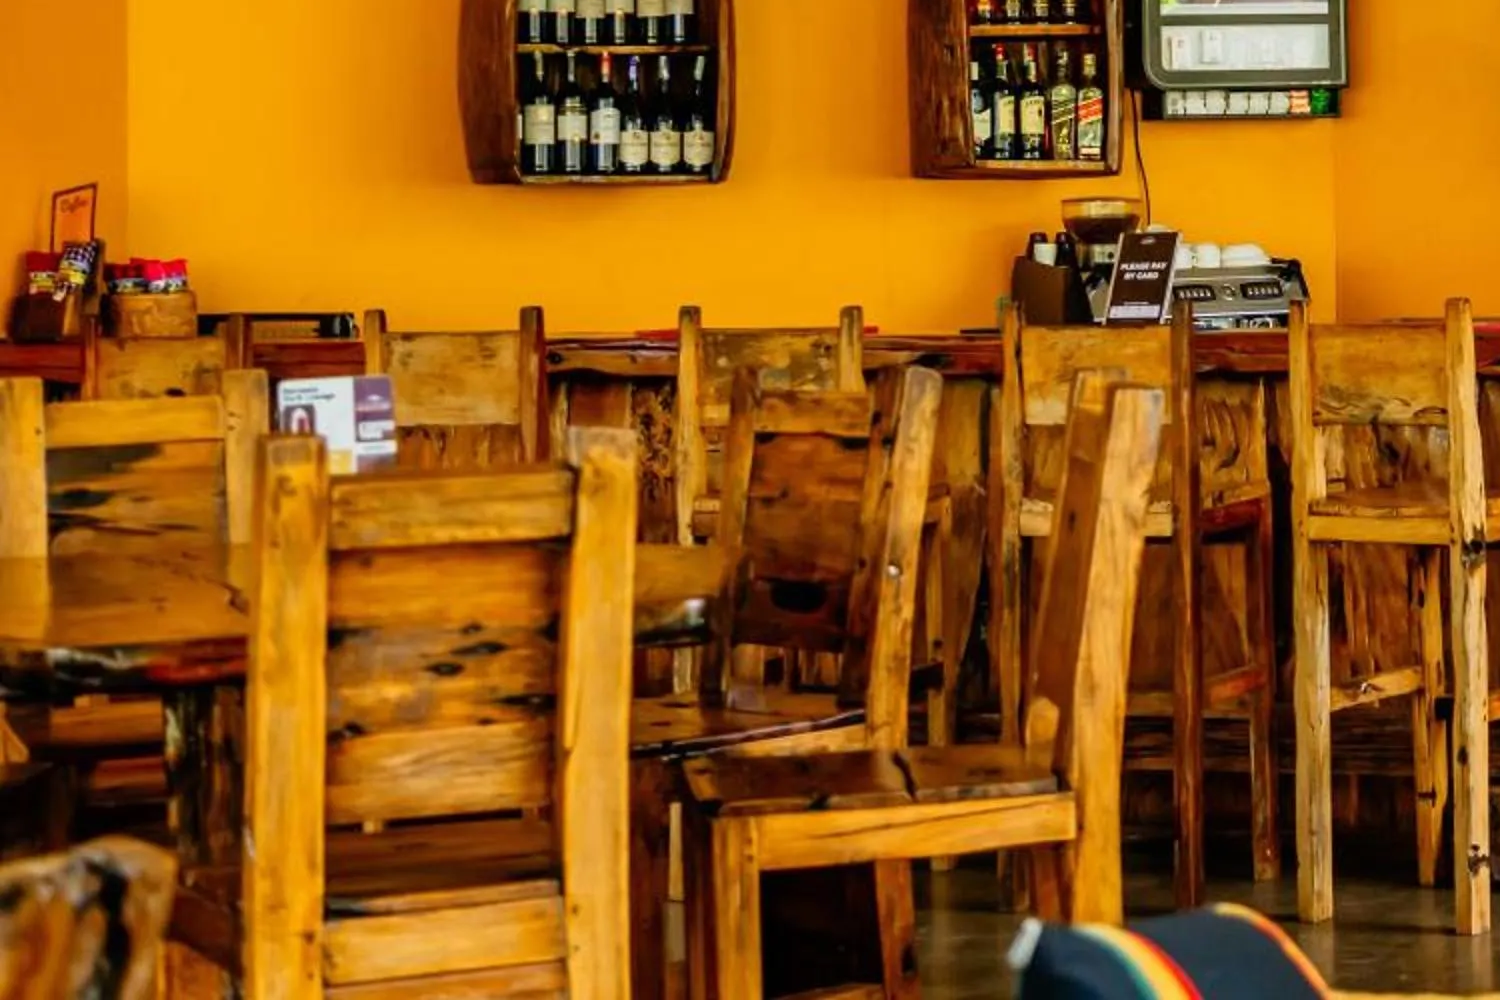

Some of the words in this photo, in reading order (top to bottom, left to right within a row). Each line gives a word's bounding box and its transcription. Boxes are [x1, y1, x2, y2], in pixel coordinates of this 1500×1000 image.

[1120, 262, 1150, 271] PLEASE
[1151, 261, 1168, 270] PAY
[1136, 271, 1160, 280] CARD
